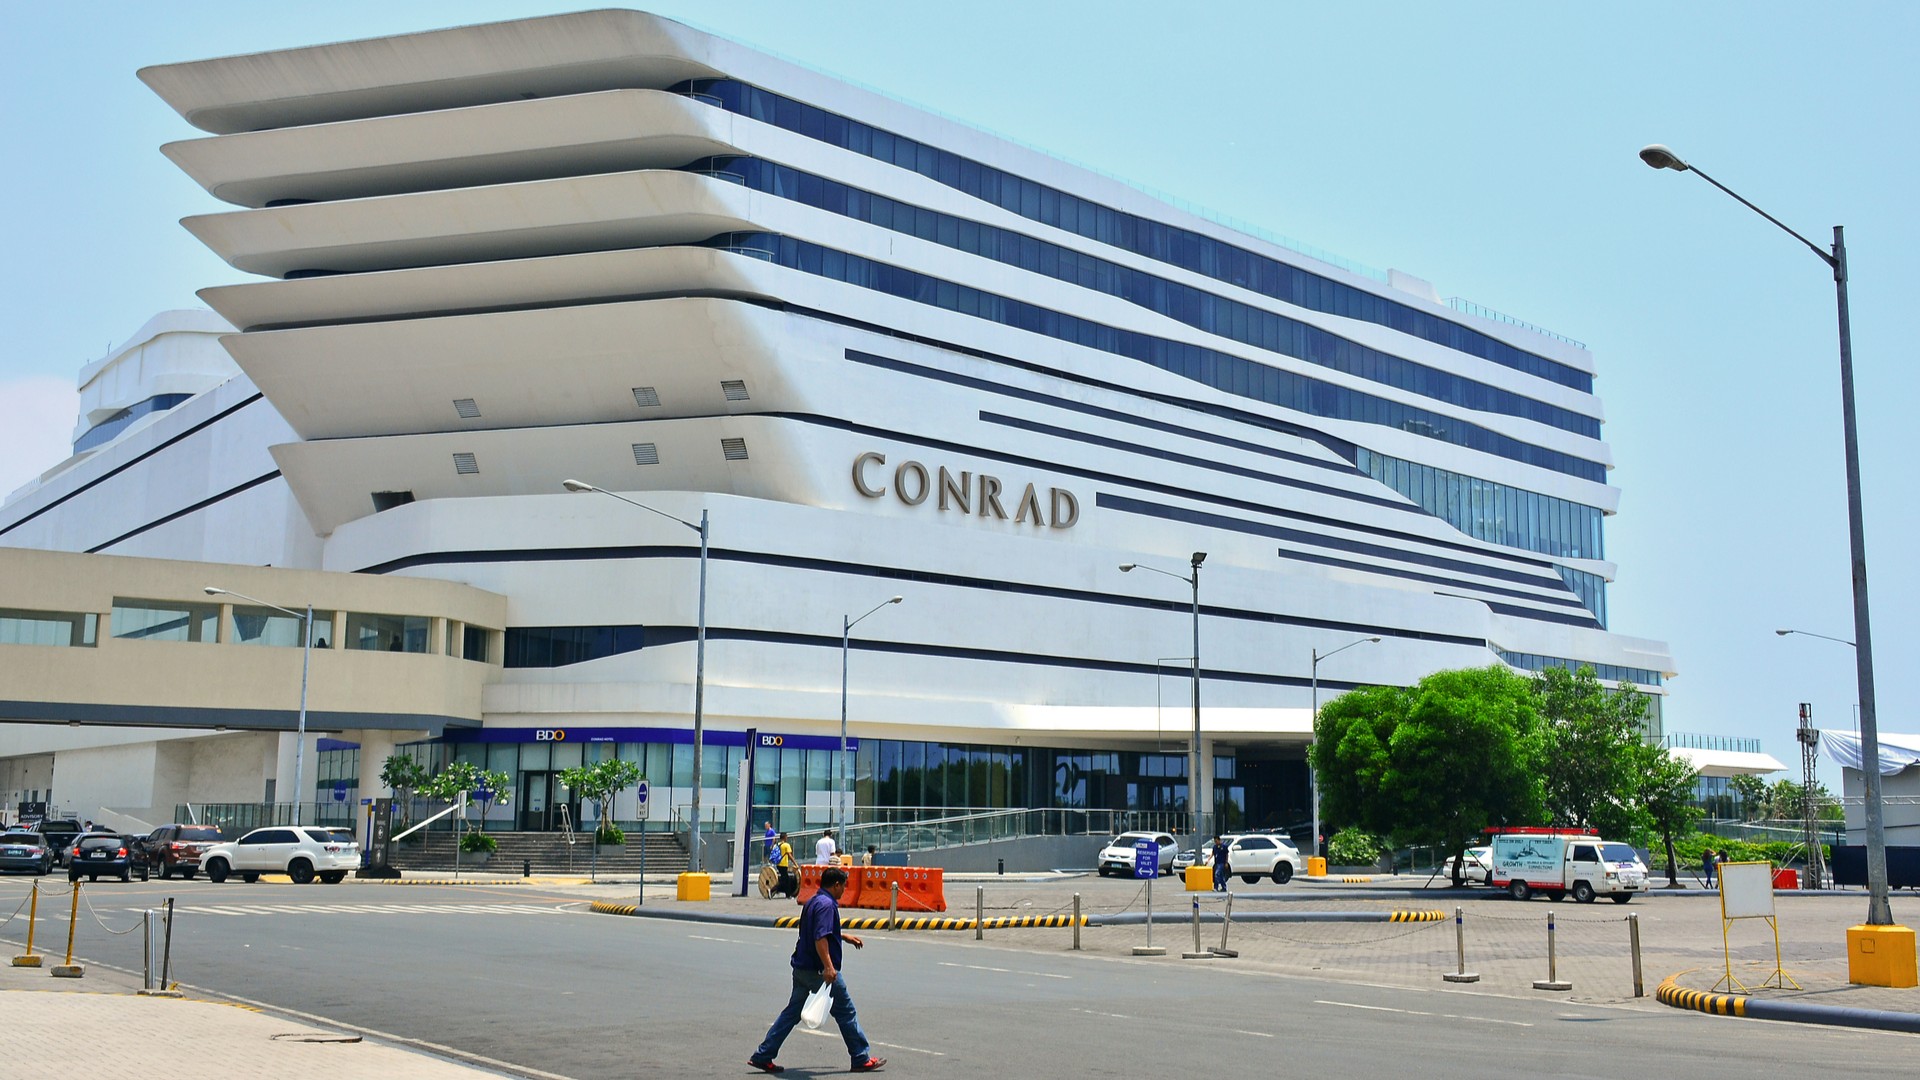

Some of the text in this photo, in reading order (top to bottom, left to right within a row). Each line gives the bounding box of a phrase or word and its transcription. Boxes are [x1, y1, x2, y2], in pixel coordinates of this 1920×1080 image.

[851, 451, 1080, 529] CONRAD
[536, 729, 565, 741] BDO
[762, 735, 783, 746] BDO
[1502, 860, 1523, 868] GROWTH
